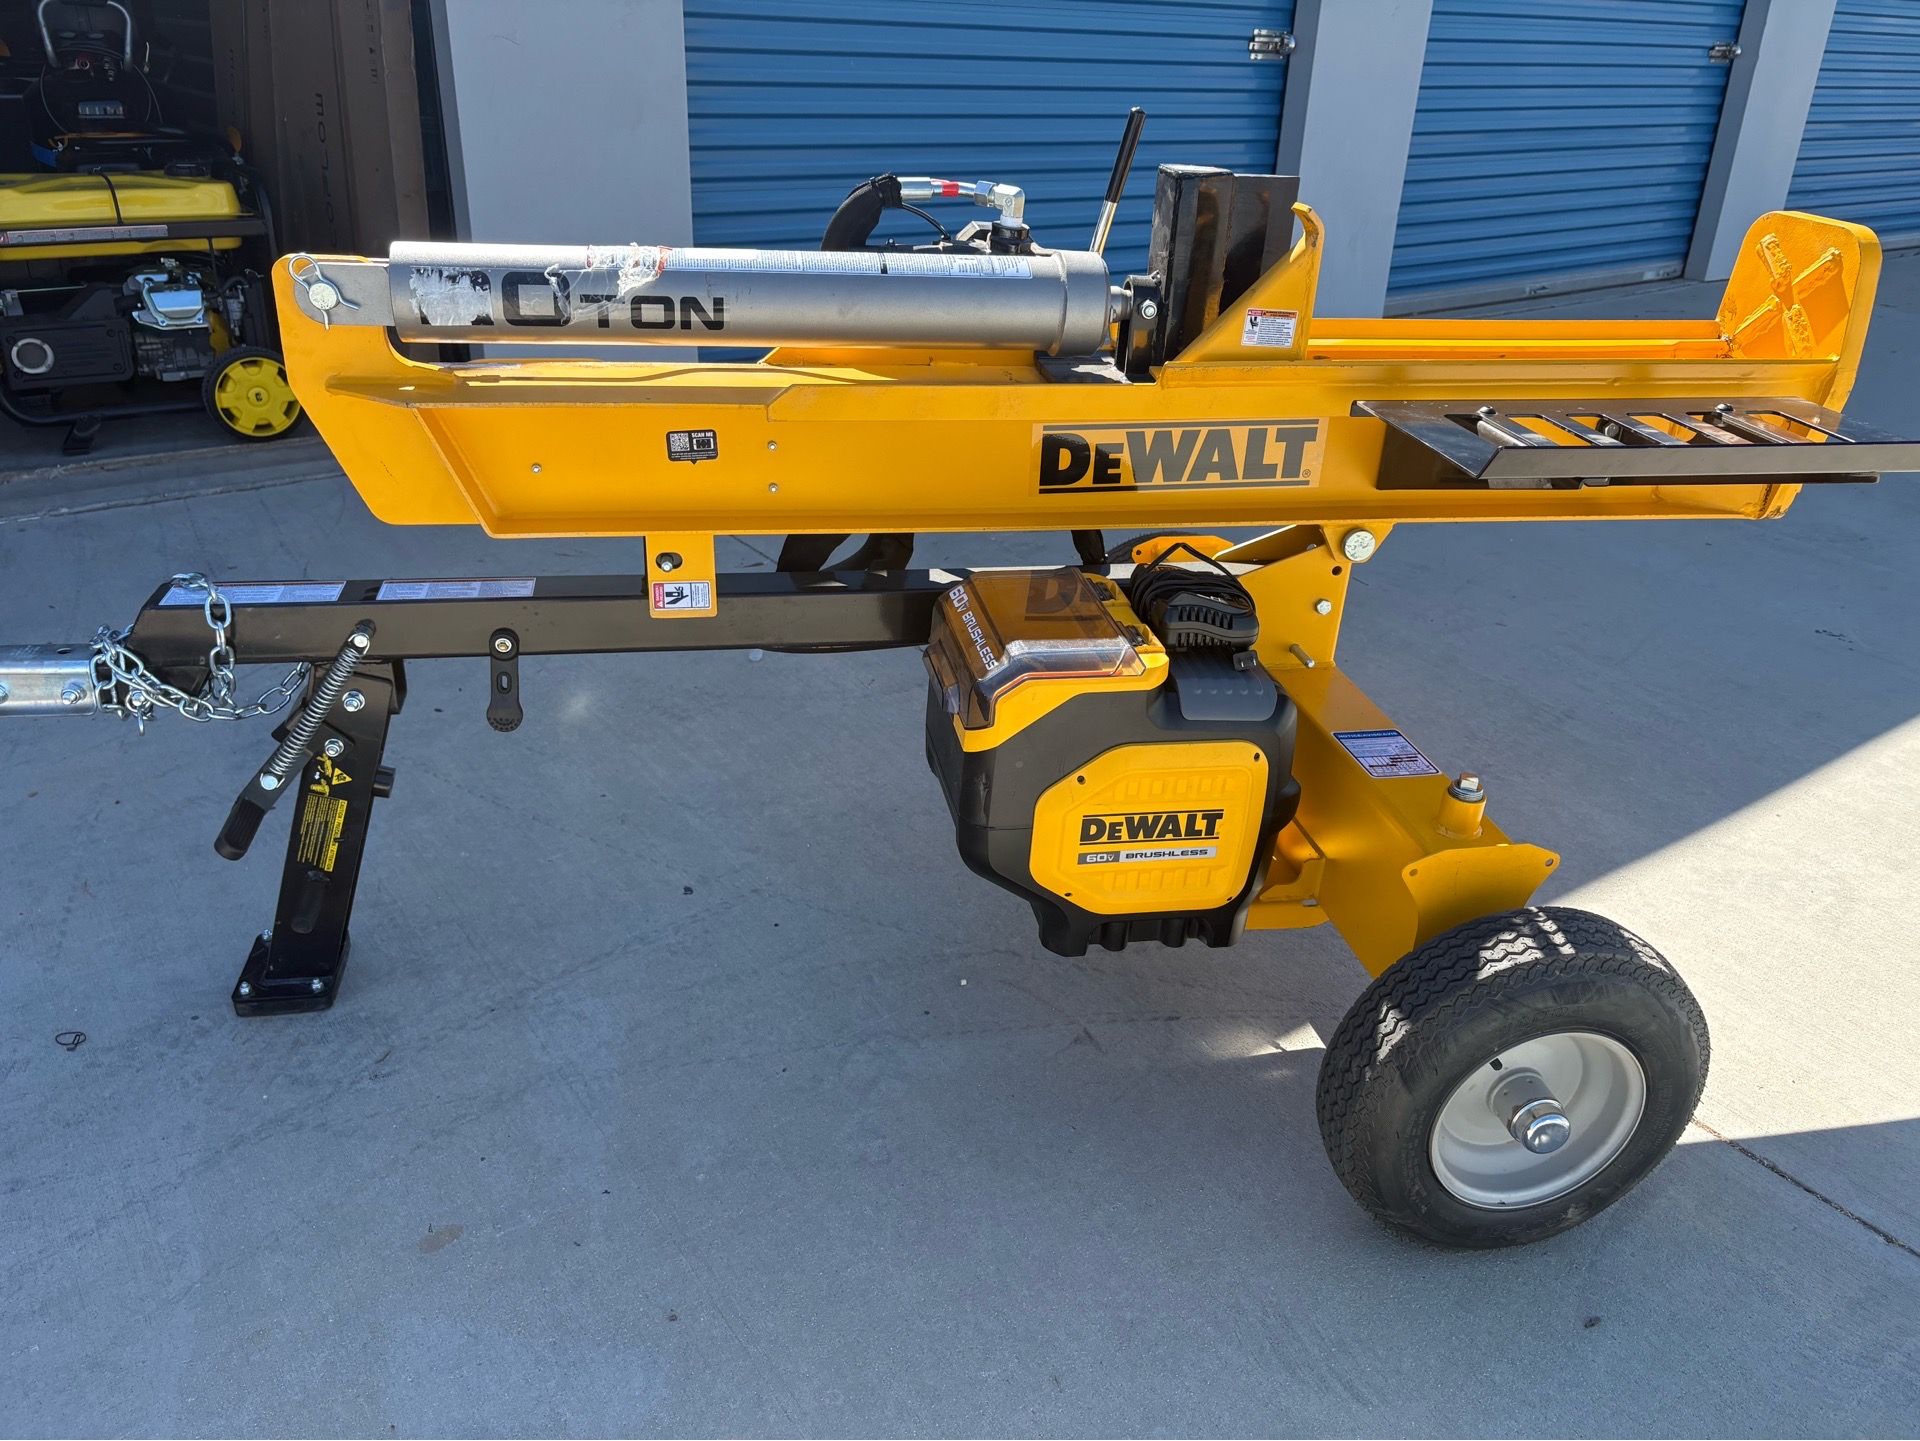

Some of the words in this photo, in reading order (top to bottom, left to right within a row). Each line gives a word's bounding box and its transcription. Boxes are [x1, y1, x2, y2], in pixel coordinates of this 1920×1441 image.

[314, 92, 338, 249] COFLOW
[962, 610, 1000, 671] BRUSHLESS
[1079, 812, 1224, 843] DEWALT
[1125, 849, 1208, 859] BRUSHLESS
